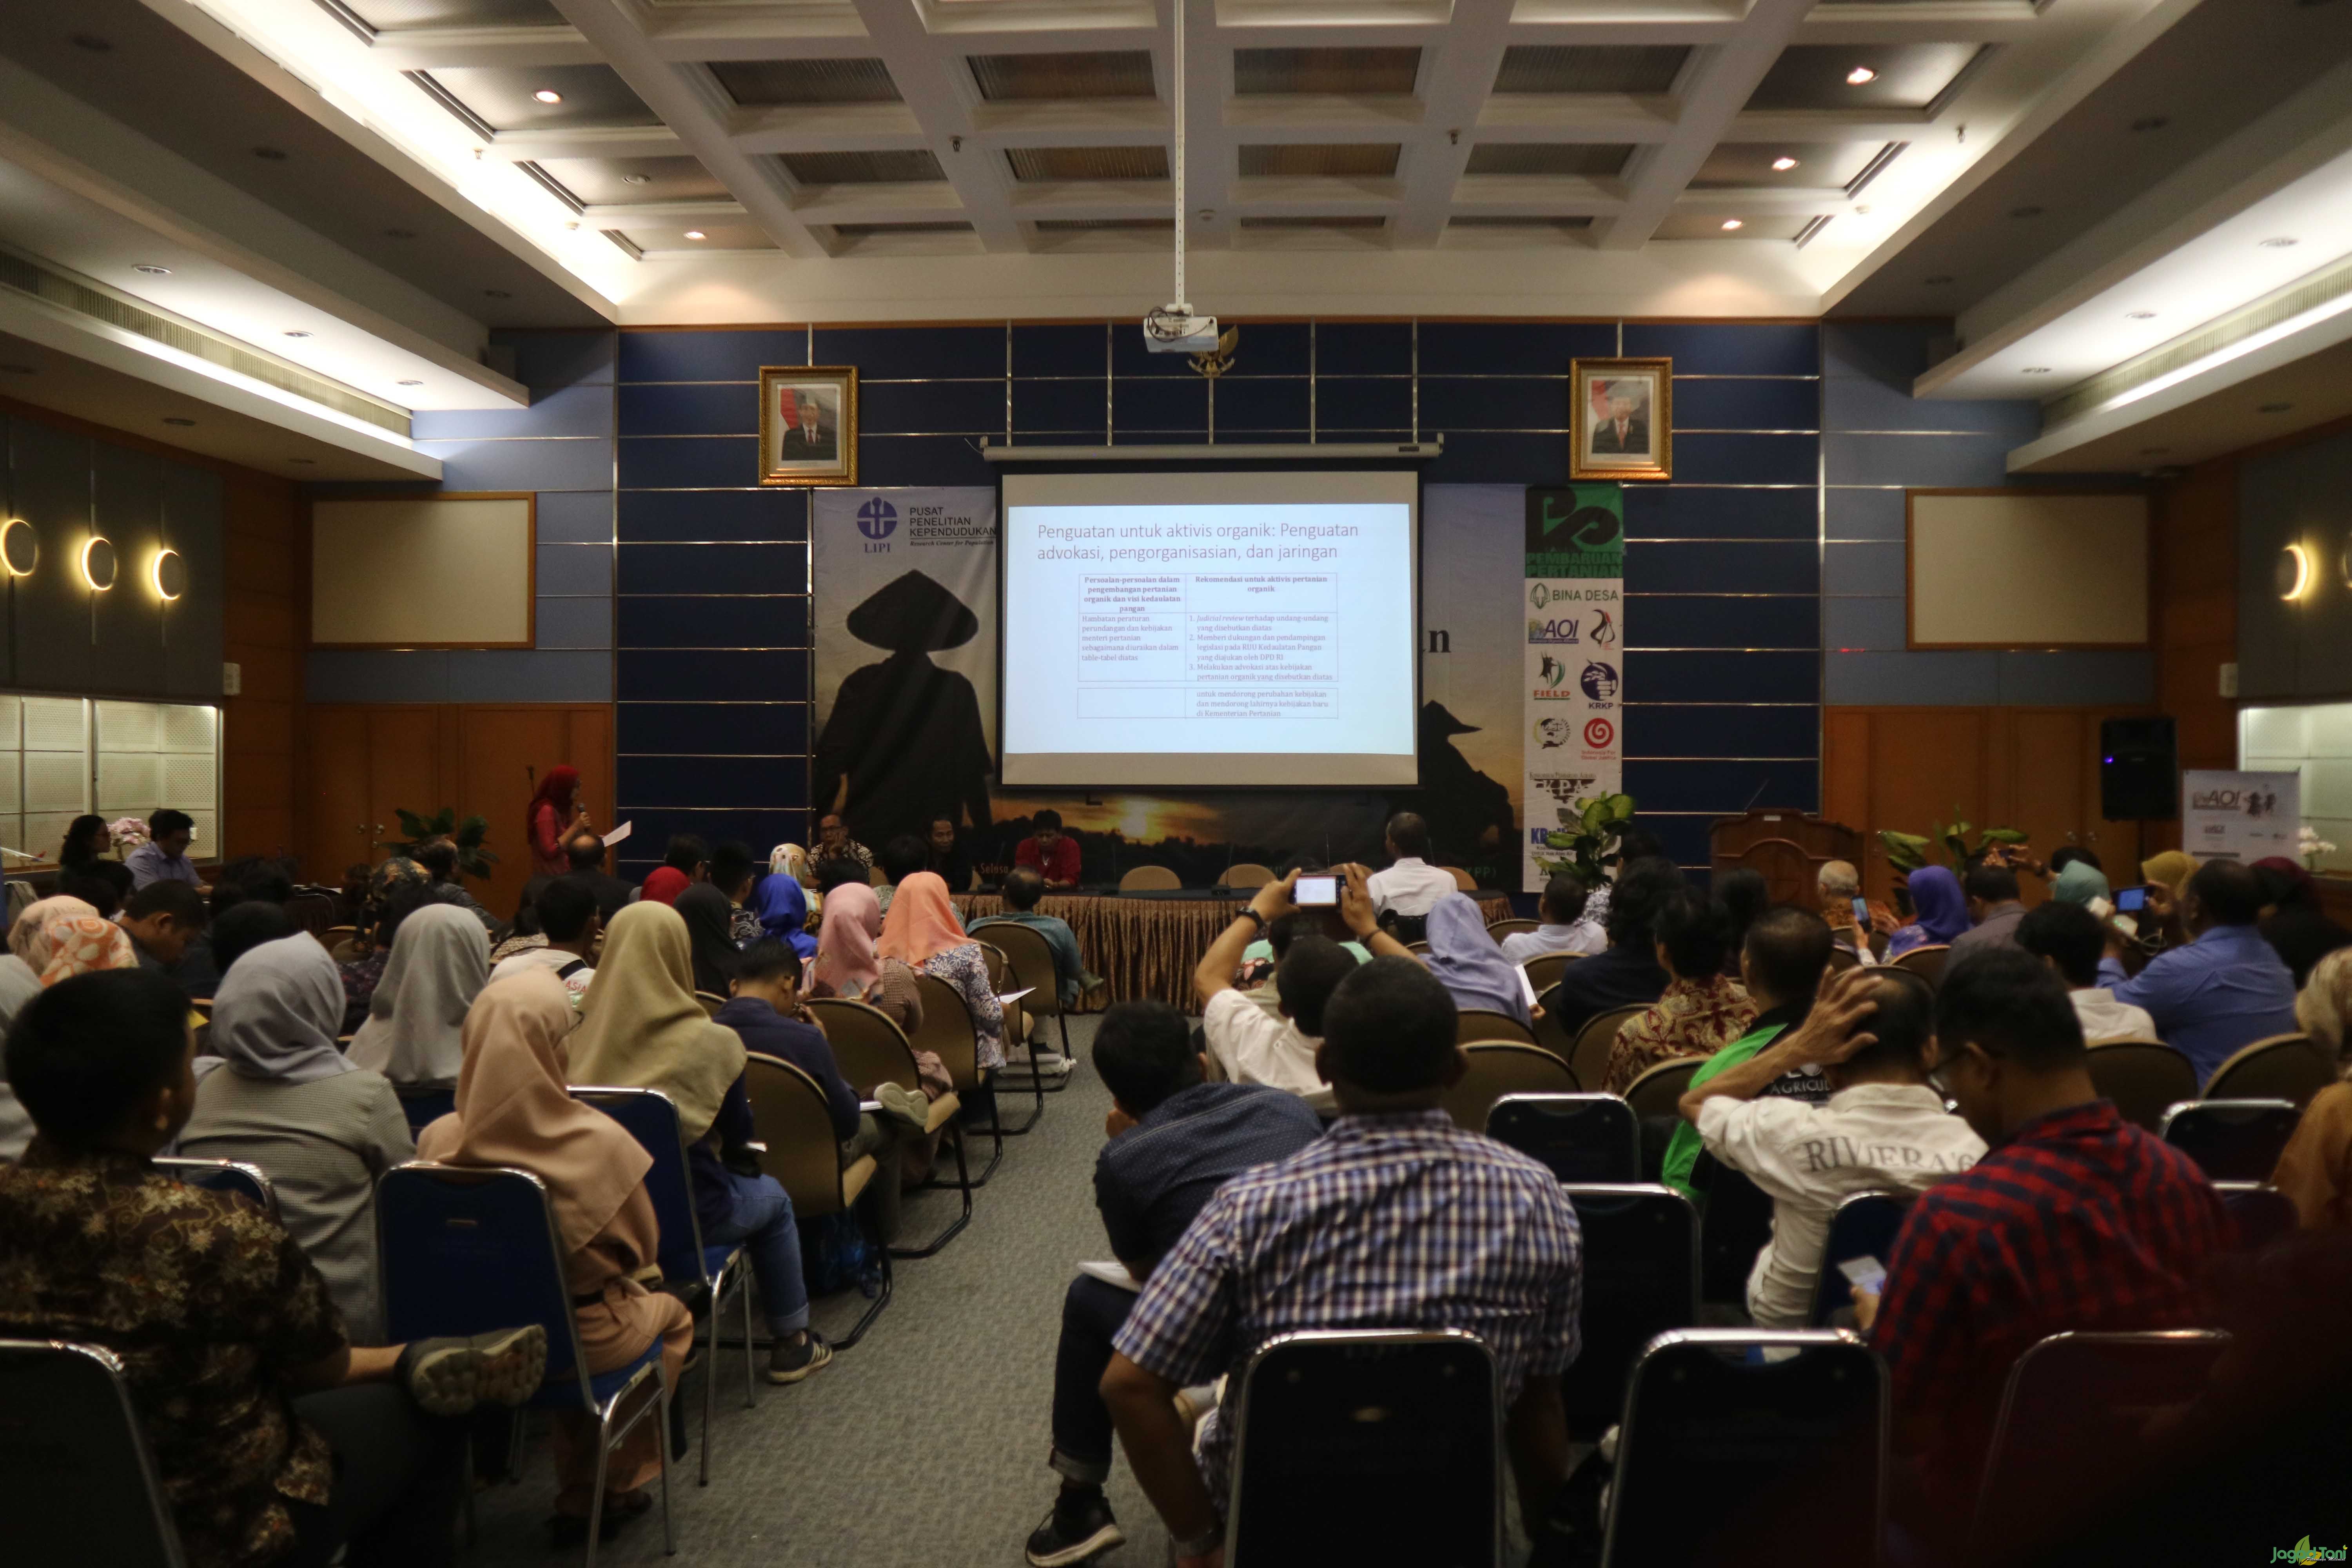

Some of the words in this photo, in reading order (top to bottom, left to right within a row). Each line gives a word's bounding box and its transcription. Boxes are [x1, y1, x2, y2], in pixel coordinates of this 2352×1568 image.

[909, 507, 944, 515] PUSAT
[910, 517, 971, 526] PENELITIAN
[909, 527, 996, 536] KEPENDUDUKAN
[1038, 525, 1114, 541] Penguatan
[1120, 523, 1162, 538] untuk
[1167, 523, 1212, 537] aktivis
[1217, 522, 1275, 540] organik:
[1281, 523, 1358, 539] Penguatan
[864, 543, 891, 553] LIPI
[1038, 546, 1104, 561] advokasi,
[1110, 545, 1240, 562] pengorganisasian,
[1246, 544, 1272, 558] dan
[1278, 544, 1337, 561] jaringan
[1553, 590, 1581, 601] BINA
[1586, 590, 1619, 601] DESA
[1543, 619, 1579, 638] AOI
[980, 862, 1008, 874] Selasa
[1770, 1079, 1830, 1094] AGRICUL
